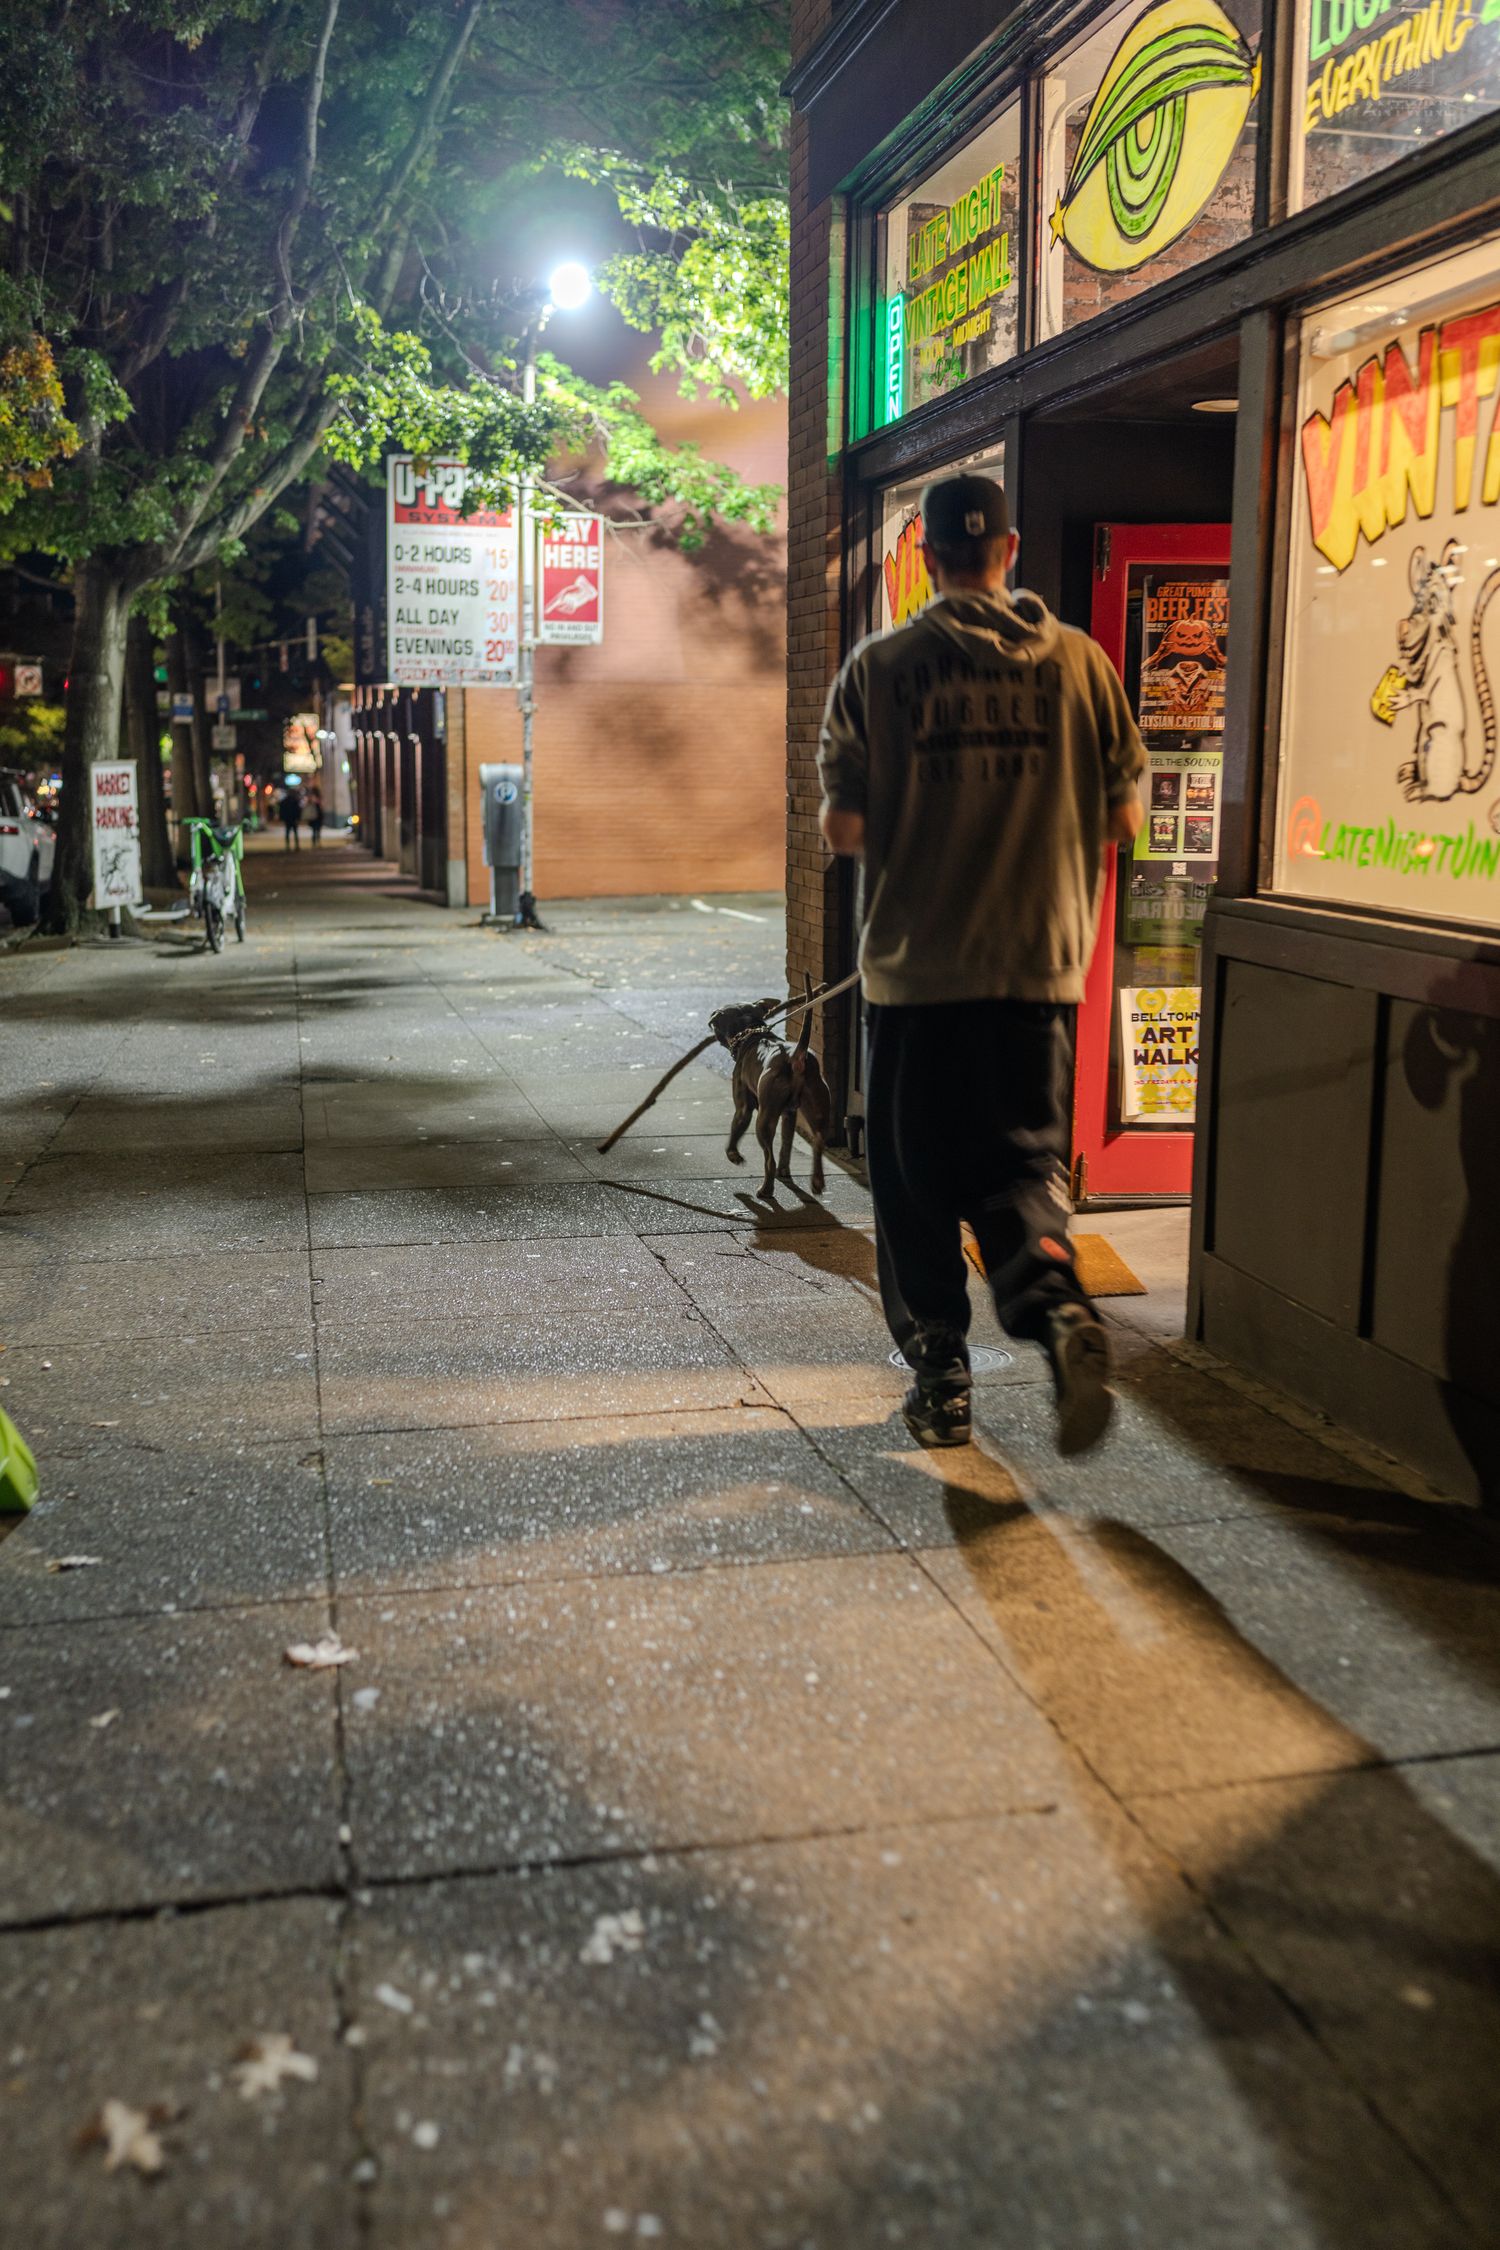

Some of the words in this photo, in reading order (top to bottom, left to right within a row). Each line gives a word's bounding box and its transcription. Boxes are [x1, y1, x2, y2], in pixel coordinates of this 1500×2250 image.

[1303, 0, 1474, 134] EVERYTHING
[908, 210, 949, 282] LATE
[949, 162, 1005, 257] NIGHT
[904, 262, 968, 348] VINTAGE
[968, 232, 1012, 312] MALL
[919, 336, 945, 368] NOON
[952, 307, 992, 350] MIDNIGHT
[887, 303, 903, 425] OPEN
[395, 463, 490, 508] U-Pa
[550, 519, 593, 543] PAY
[394, 544, 420, 562] 0-2
[424, 545, 472, 565] HOURS
[544, 544, 599, 570] HERE
[394, 577, 422, 595] 2-4
[425, 578, 480, 597] HOURS
[1157, 586, 1185, 598] GREAT
[396, 607, 423, 625] ALL
[428, 608, 460, 626] DAY
[1145, 598, 1190, 623] BEER
[1194, 598, 1231, 623] FEST
[395, 637, 474, 657] EVENINGS
[1139, 715, 1174, 729] ELYSIAN
[1147, 757, 1164, 767] EEL
[1165, 757, 1182, 767] THE
[1183, 757, 1221, 767] SOUND
[96, 773, 130, 796] MARKET
[96, 805, 135, 829] PARKING
[1131, 1011, 1201, 1023] BELLTOWN
[1141, 1026, 1193, 1044] ART
[1133, 1048, 1200, 1066] WALK
